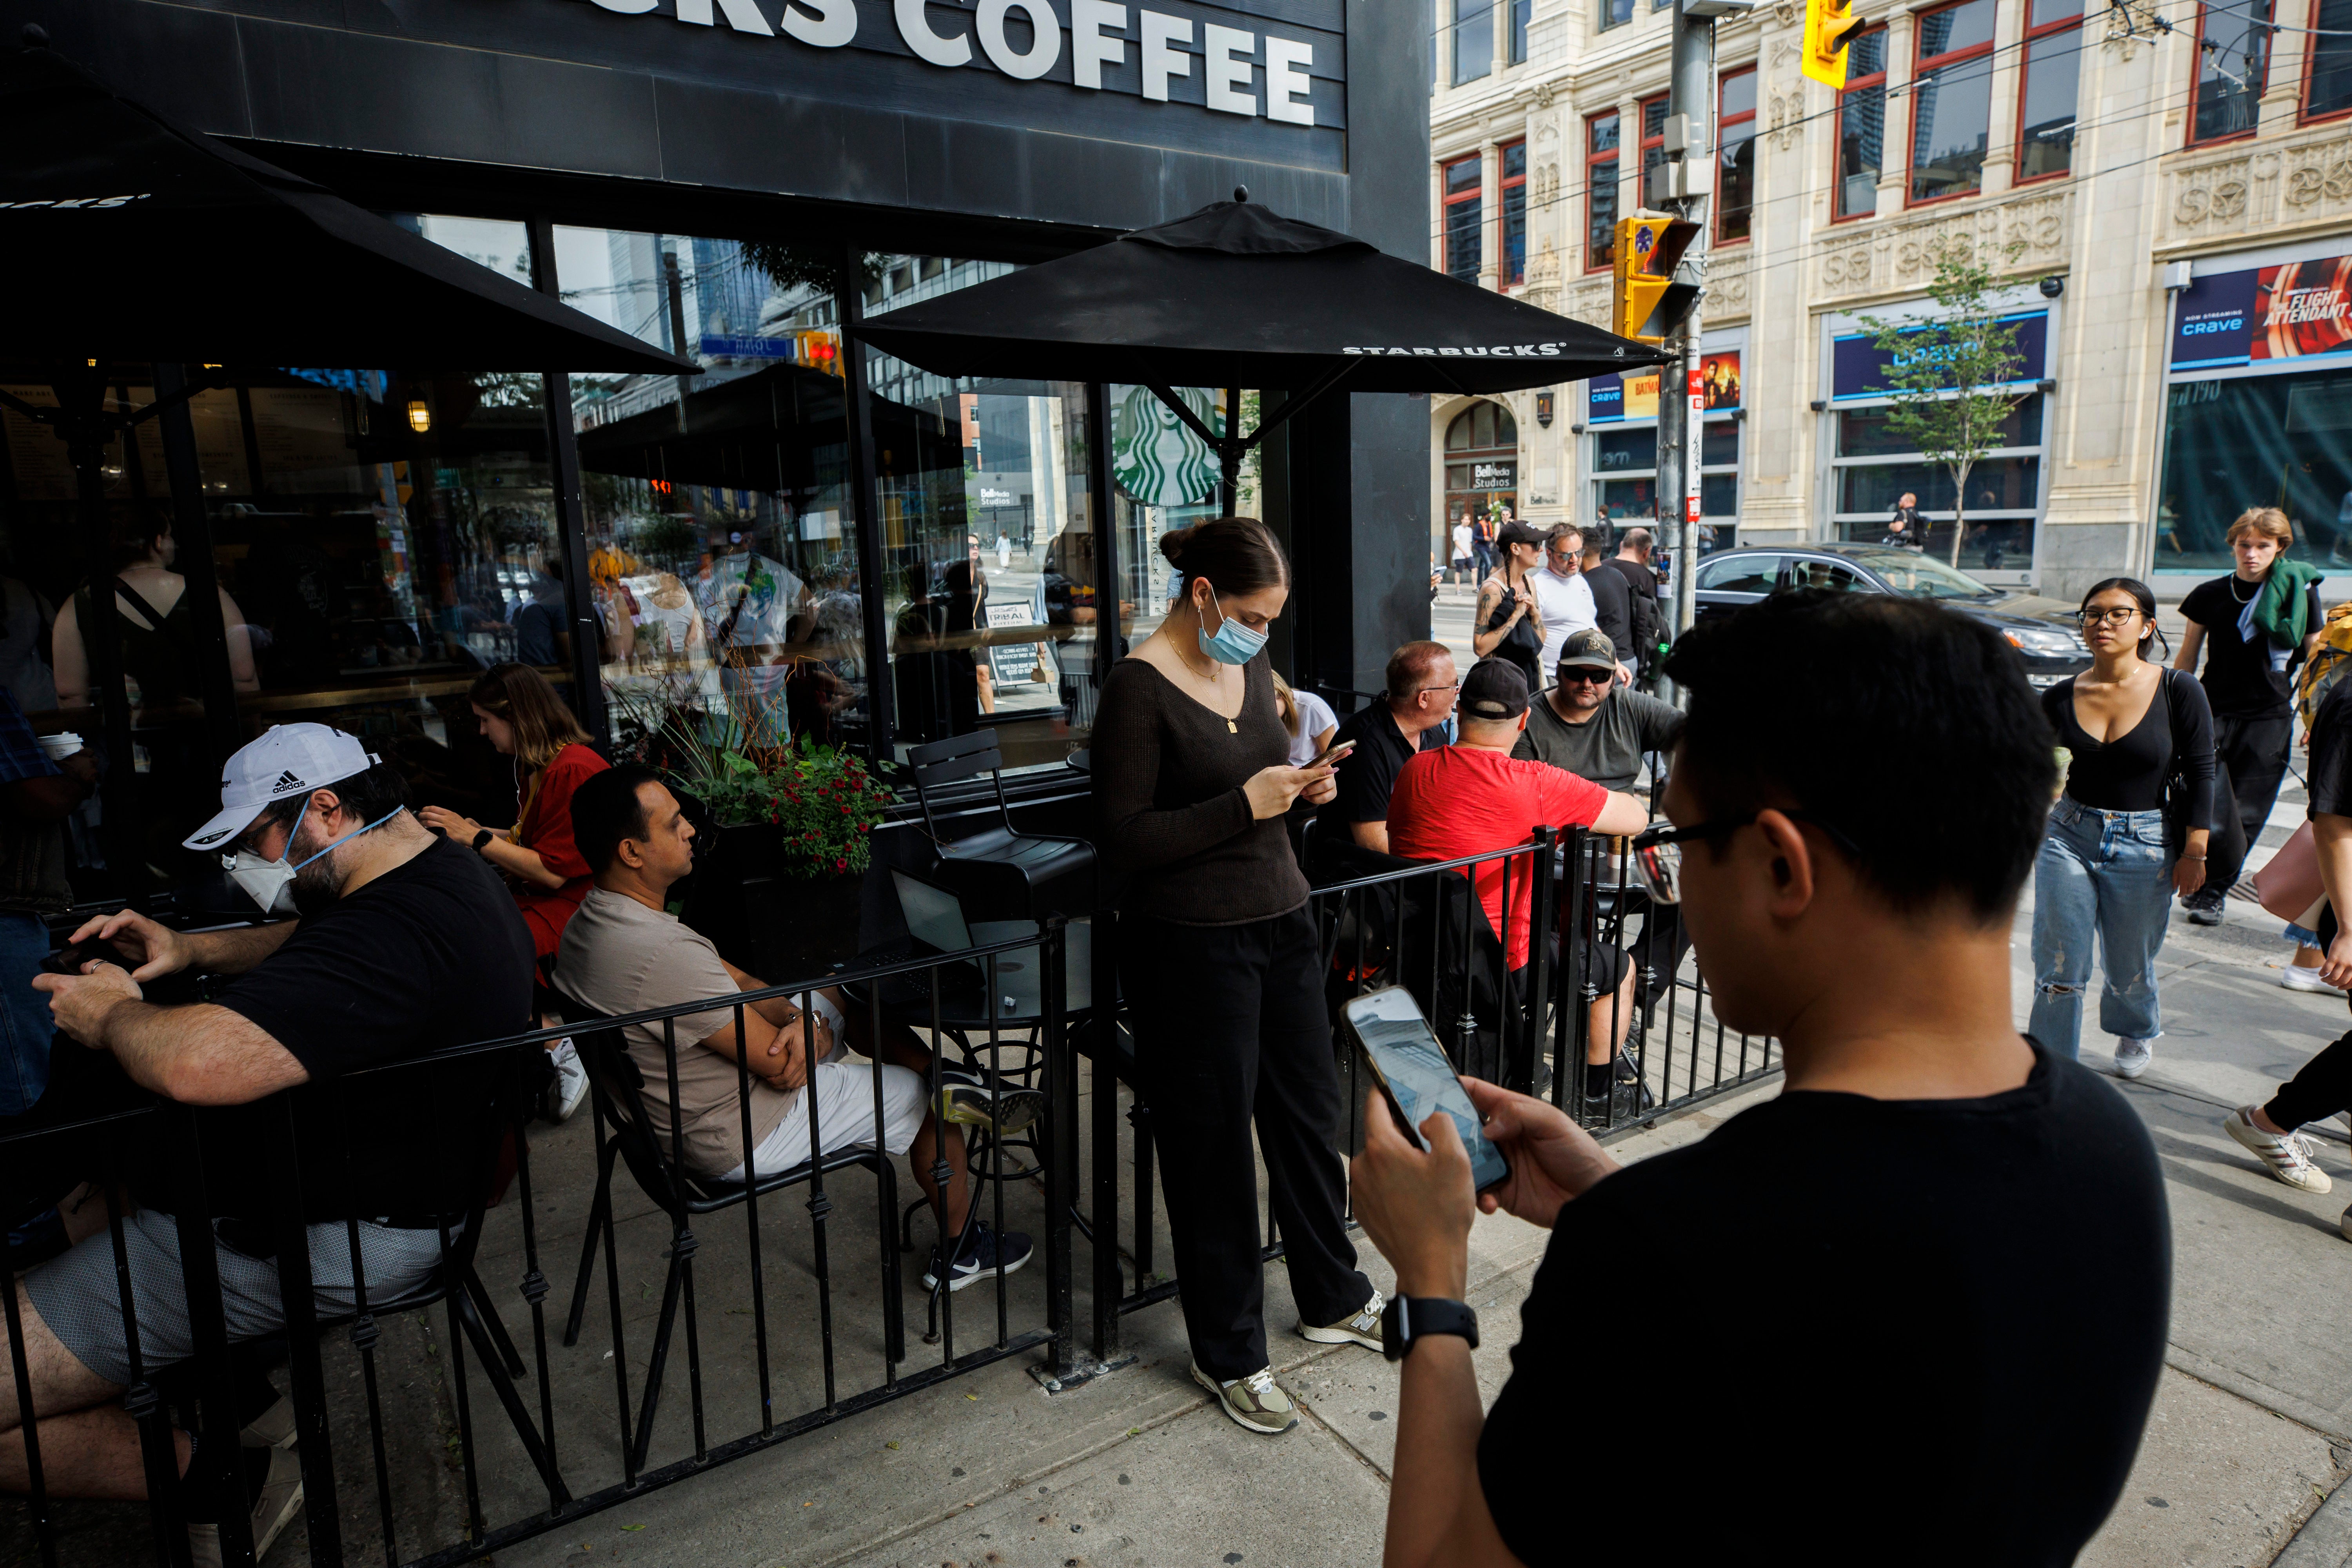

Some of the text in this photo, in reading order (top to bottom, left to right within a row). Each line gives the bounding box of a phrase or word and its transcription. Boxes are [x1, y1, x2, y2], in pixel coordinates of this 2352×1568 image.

[895, 0, 1314, 126] COFFEE
[2290, 289, 2343, 309] FLIGHT
[2202, 309, 2243, 319] STREAMING
[2262, 302, 2350, 327] ATTENDANT
[1475, 477, 1510, 488] Studios
[989, 613, 1025, 621] TRIBAL
[272, 780, 305, 794] adidas
